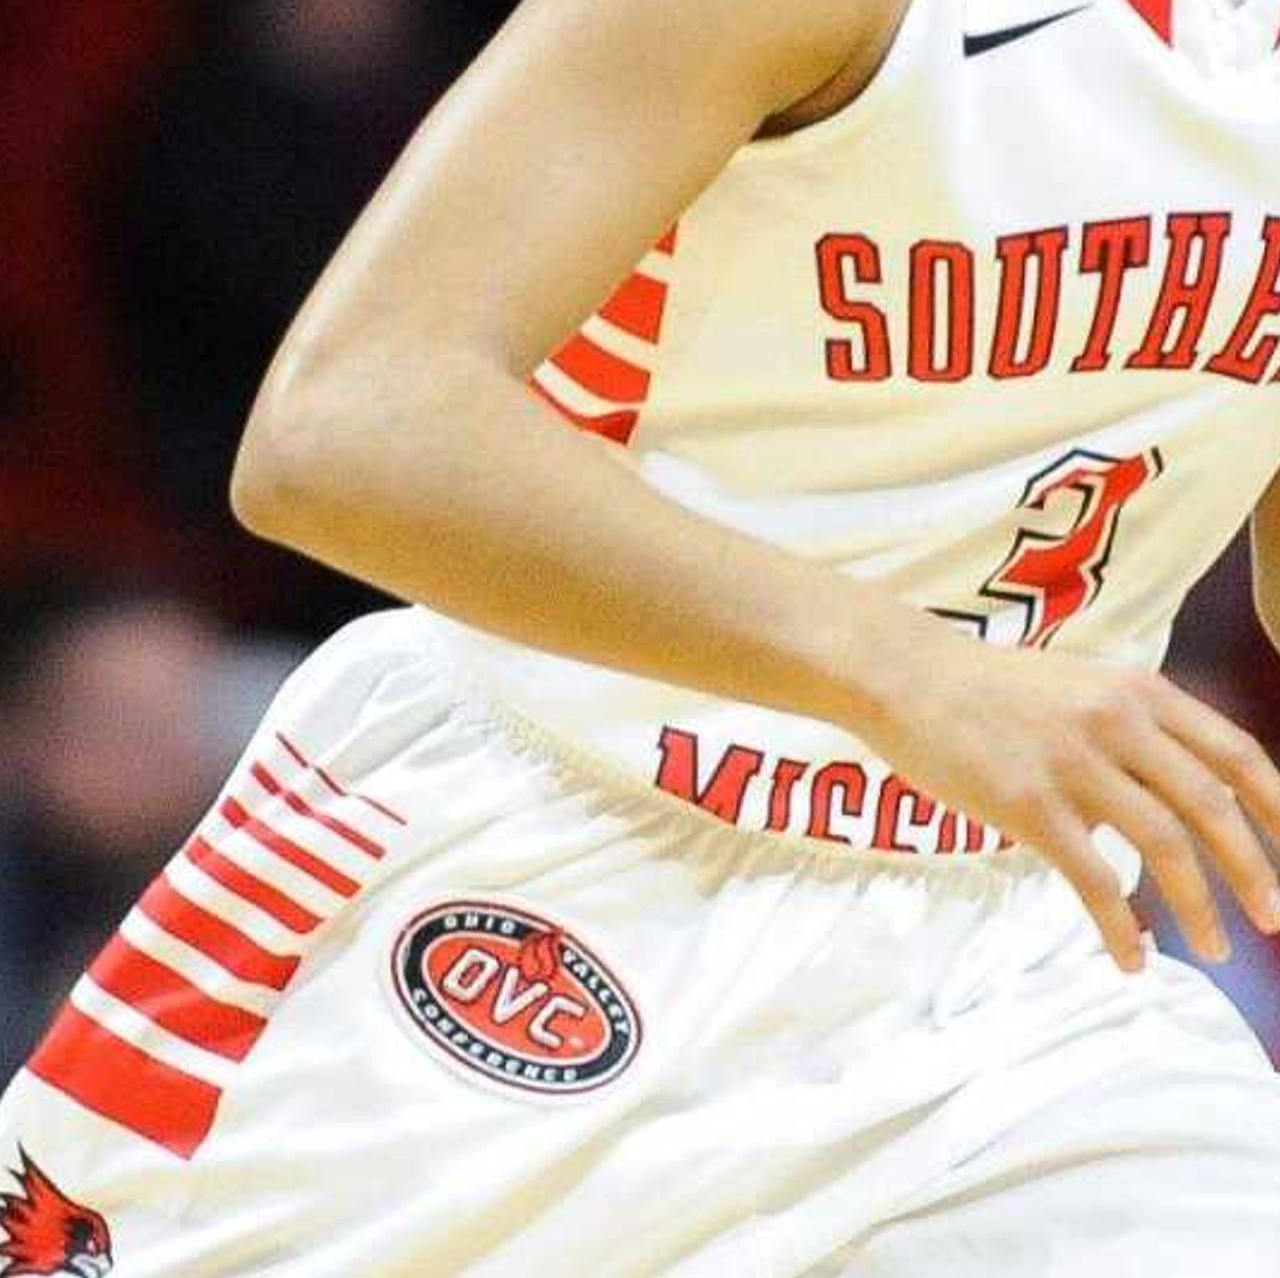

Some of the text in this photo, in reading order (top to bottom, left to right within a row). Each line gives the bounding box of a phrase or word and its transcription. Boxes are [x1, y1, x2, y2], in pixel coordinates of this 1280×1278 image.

[925, 446, 1164, 652] 3
[440, 947, 589, 1049] OVC
[443, 912, 631, 1035] OHIO VALLEY
